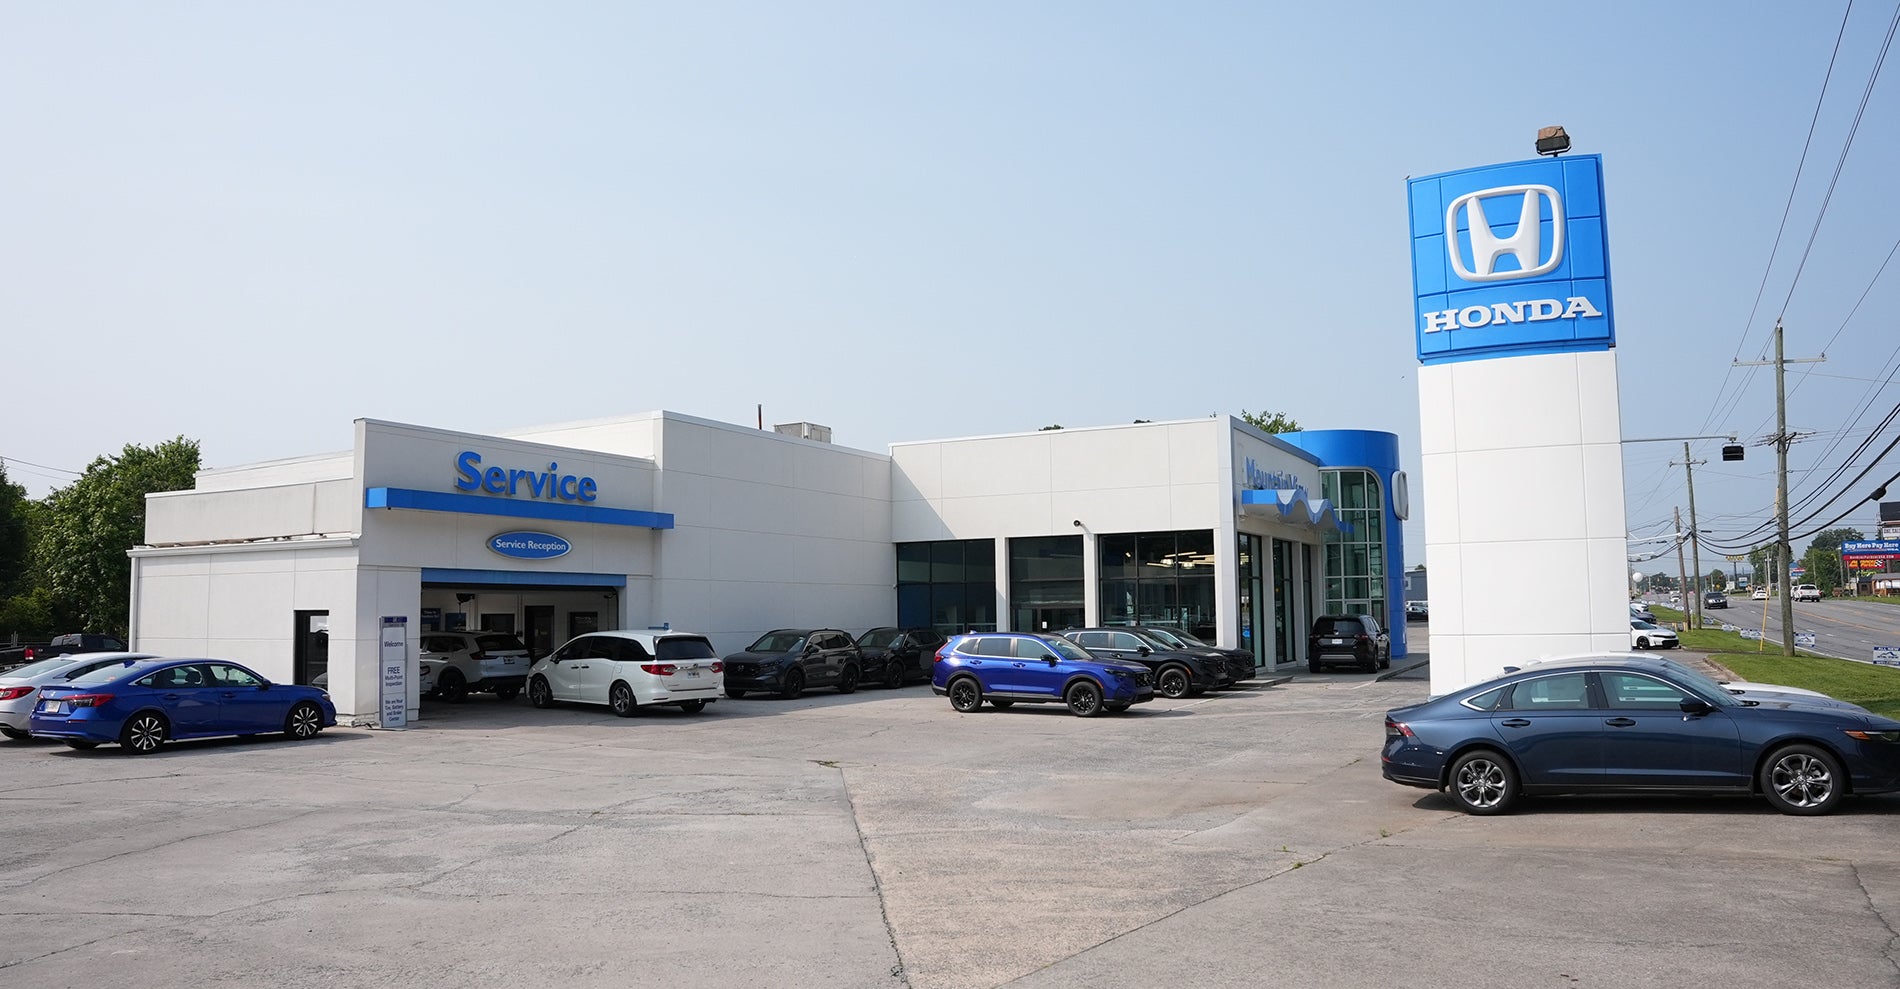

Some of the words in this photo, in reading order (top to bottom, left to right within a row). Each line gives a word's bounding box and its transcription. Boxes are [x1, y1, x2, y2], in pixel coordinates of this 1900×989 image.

[1424, 296, 1602, 333] HONDA
[457, 451, 597, 502] Service
[1245, 456, 1288, 489] Mountain
[496, 539, 526, 548] Service
[528, 540, 566, 552] Reception
